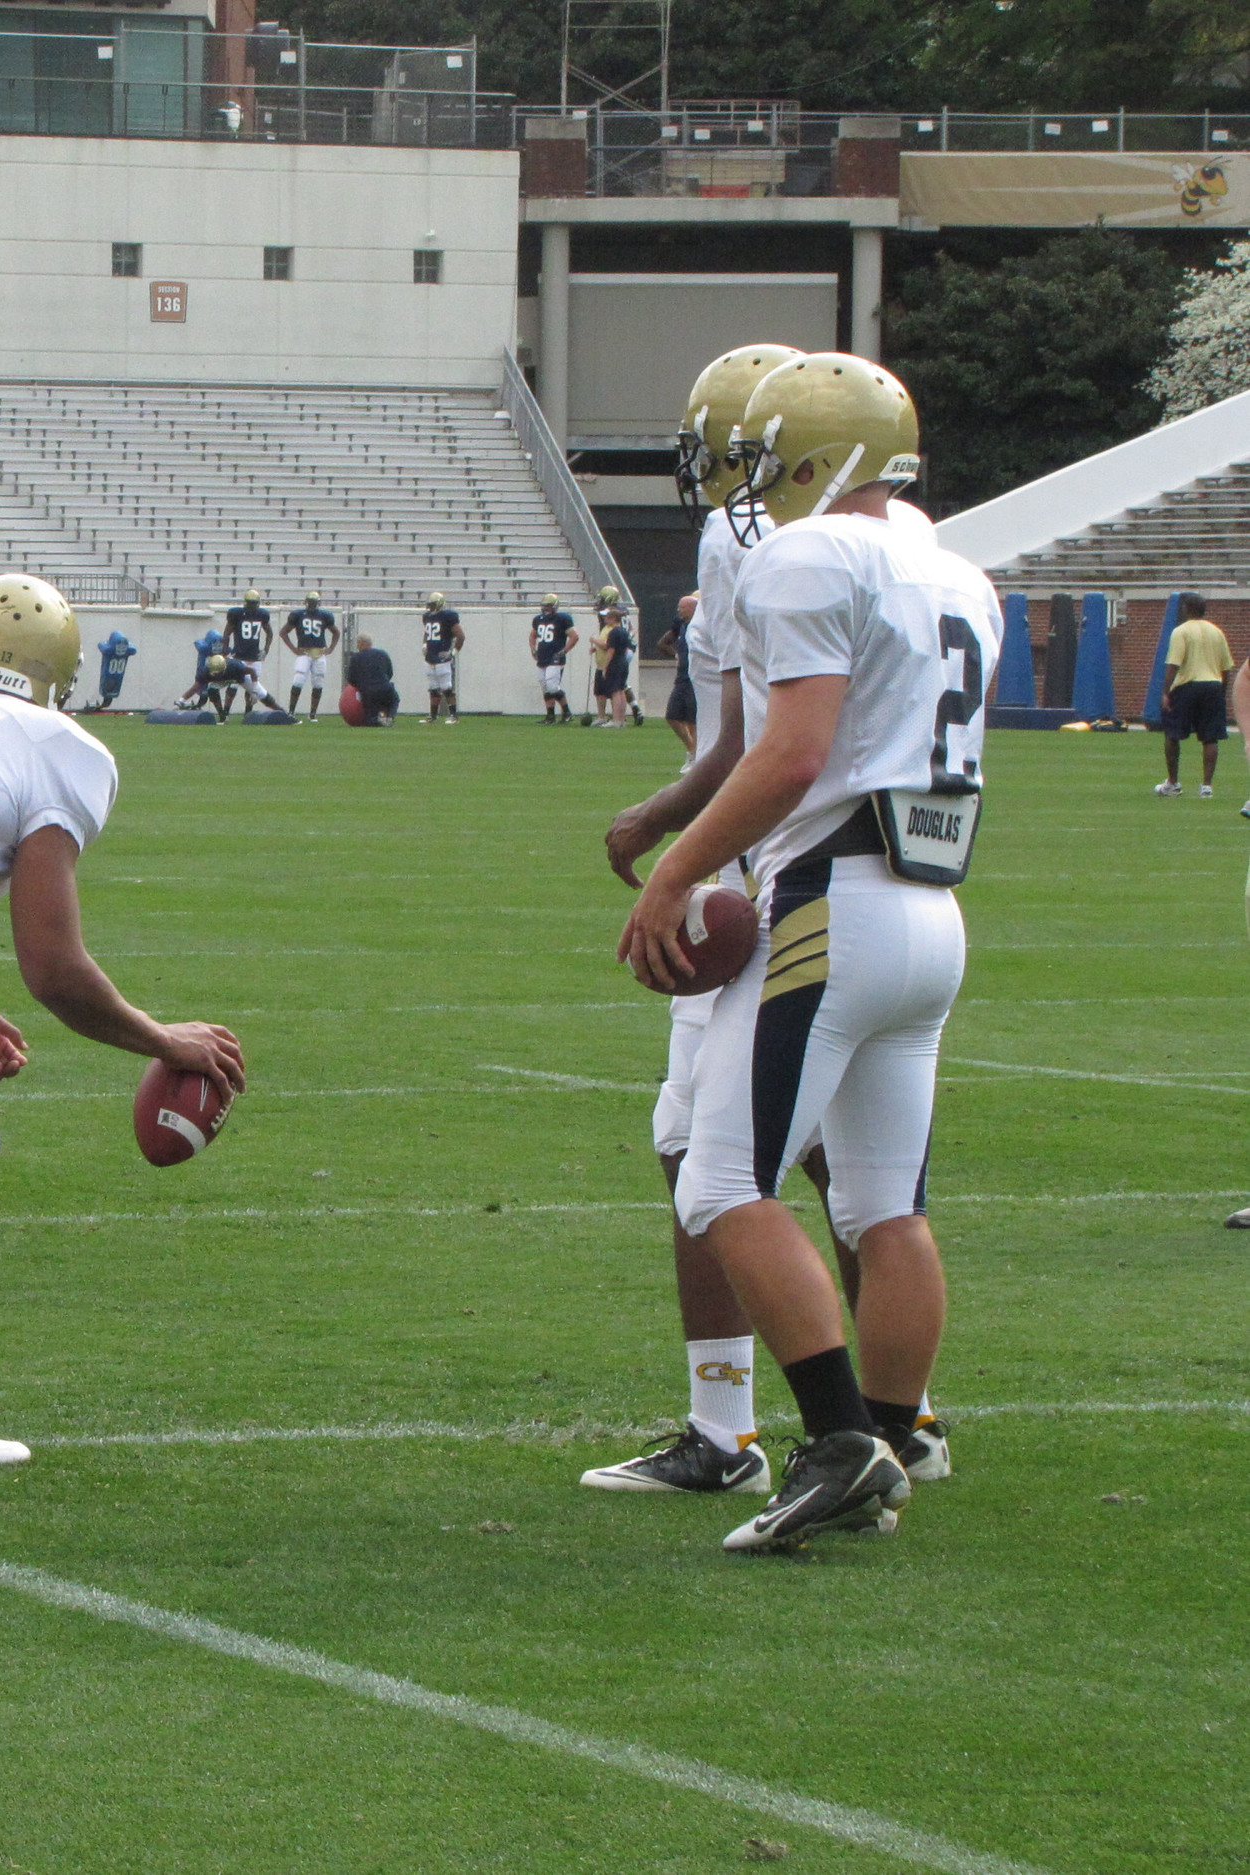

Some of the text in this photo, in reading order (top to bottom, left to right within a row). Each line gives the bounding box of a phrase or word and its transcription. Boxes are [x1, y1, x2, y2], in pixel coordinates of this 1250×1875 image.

[157, 297, 181, 312] 136
[241, 621, 262, 640] 87
[302, 618, 323, 638] 95
[425, 622, 441, 641] 92
[537, 624, 555, 643] 96
[1, 651, 13, 664] 13
[930, 613, 983, 795] 2
[906, 806, 962, 844] DOUGLAS
[695, 1361, 751, 1386] GT
